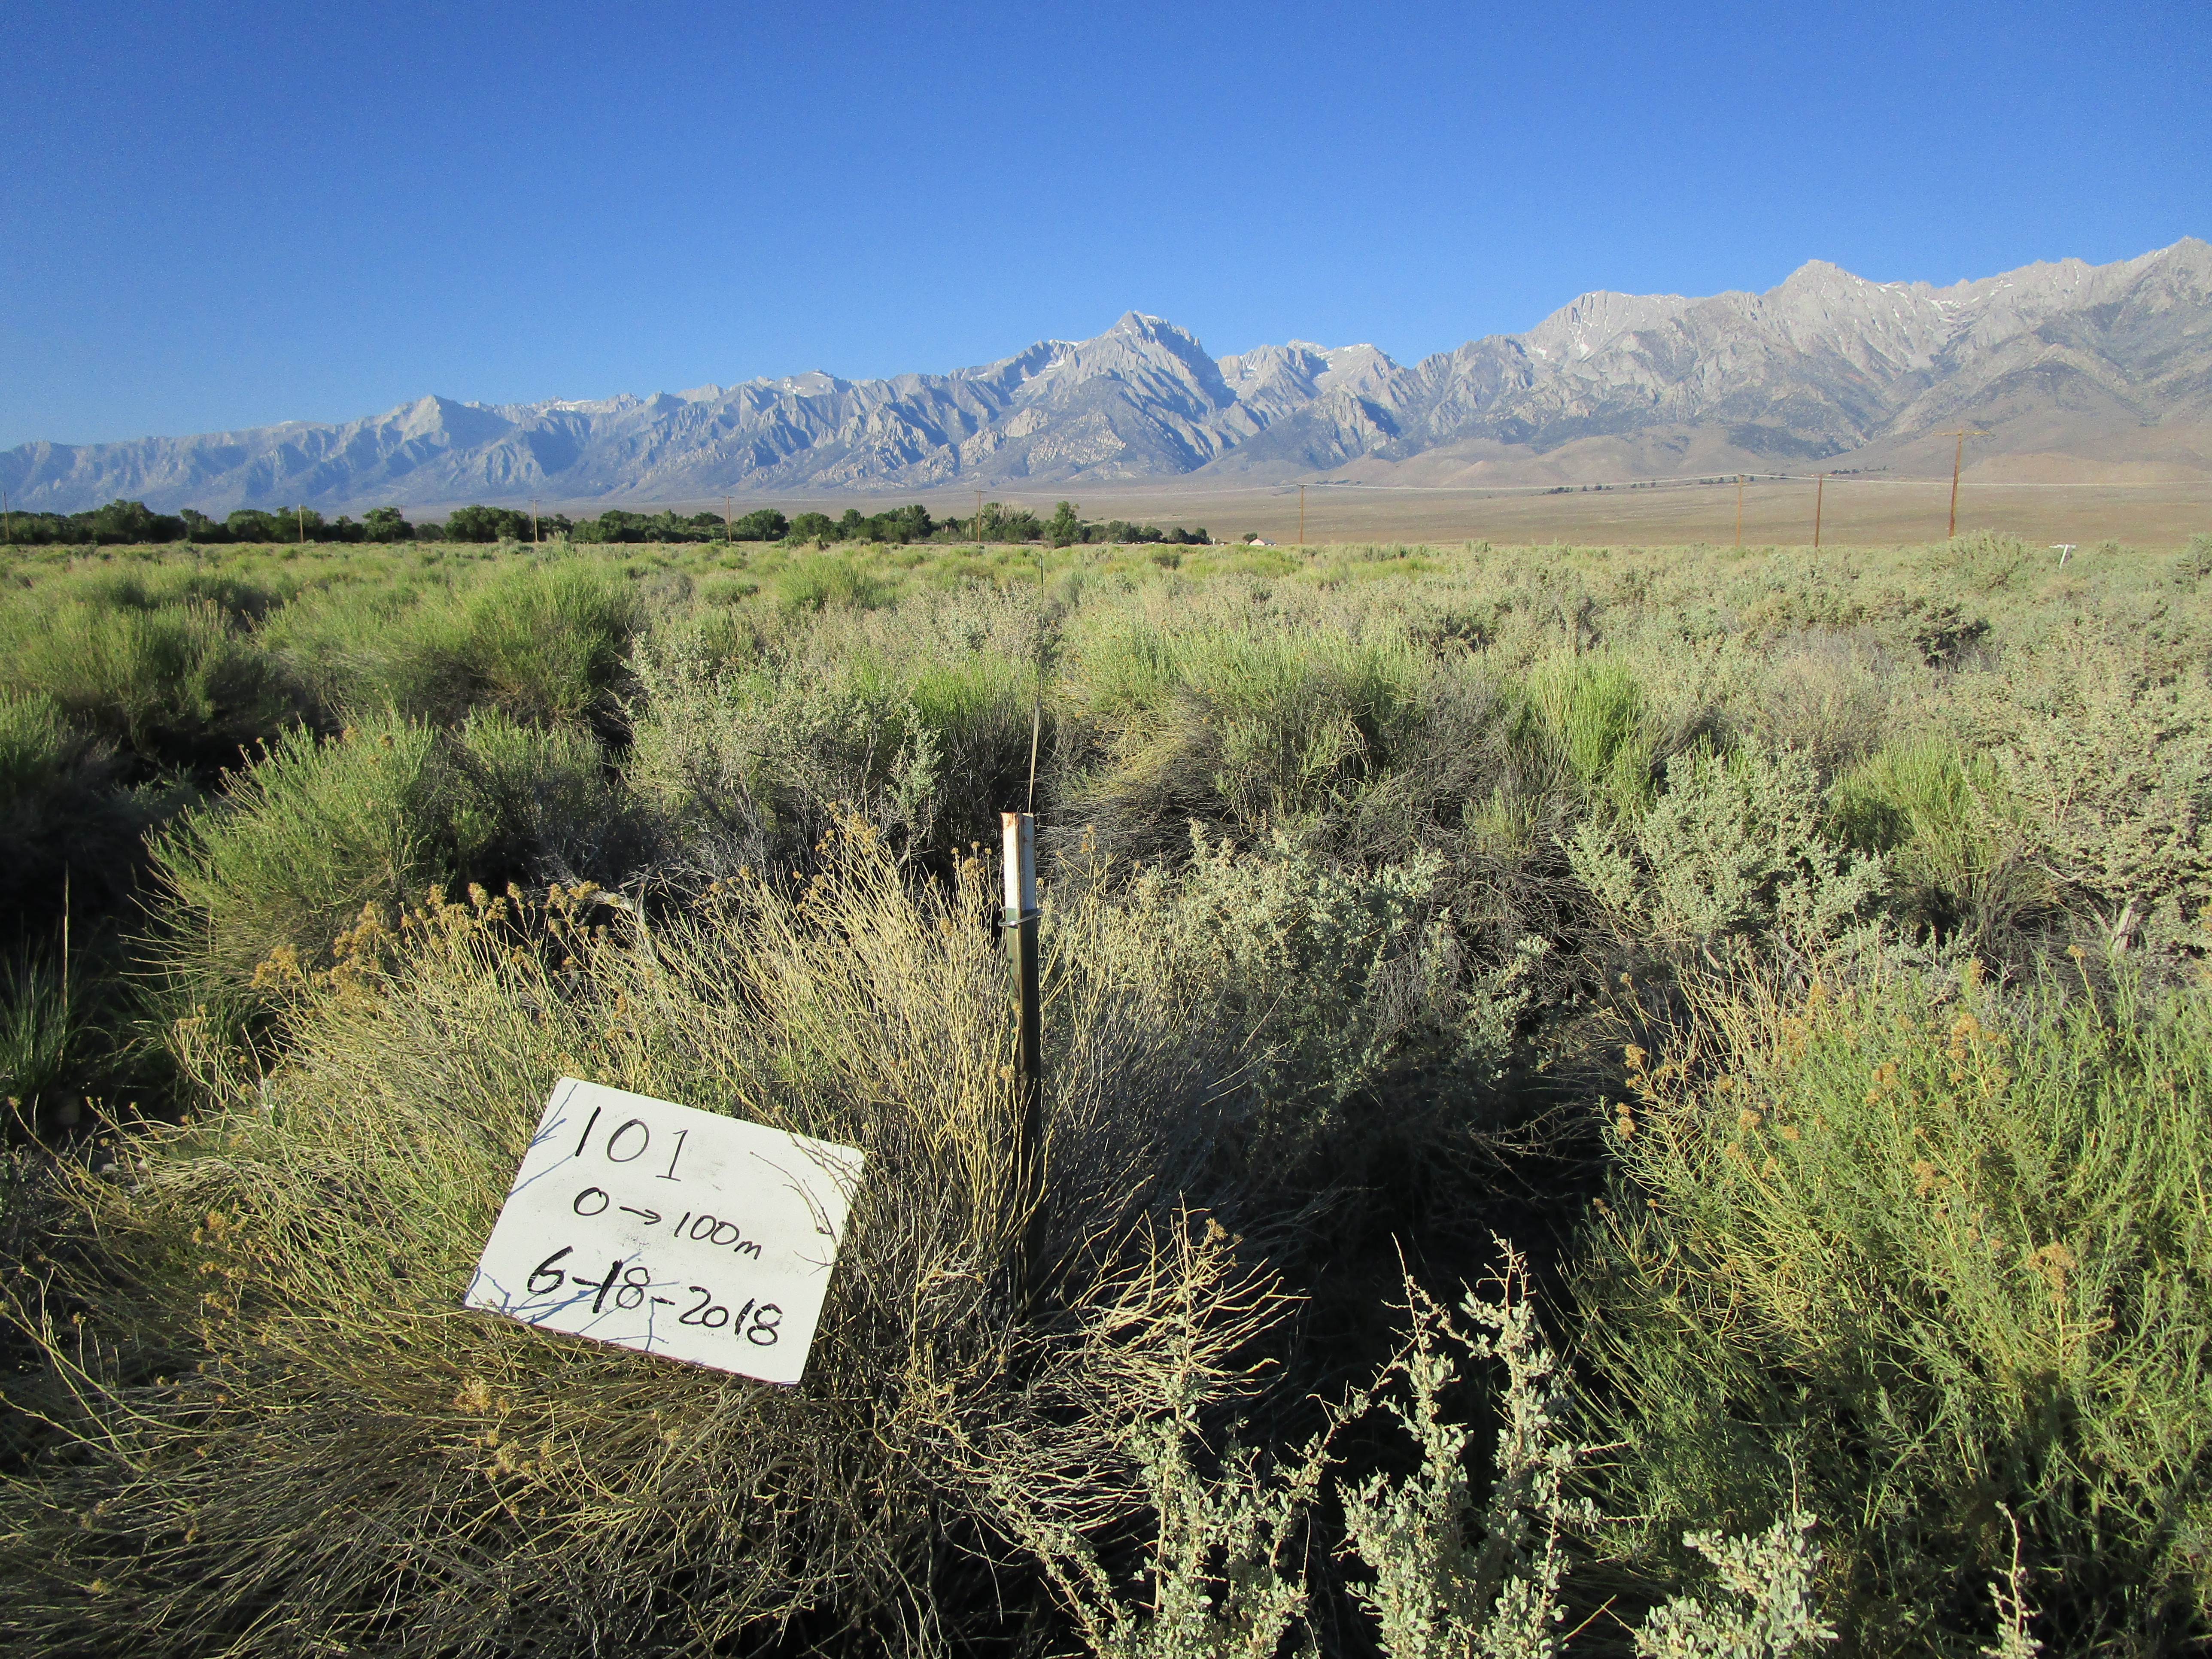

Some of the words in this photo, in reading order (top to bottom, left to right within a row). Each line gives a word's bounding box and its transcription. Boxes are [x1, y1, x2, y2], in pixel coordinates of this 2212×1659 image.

[575, 1106, 688, 1182] 101
[573, 1187, 609, 1216] 0
[674, 1212, 762, 1260] 100m
[526, 1246, 784, 1346] 6-18-2018
